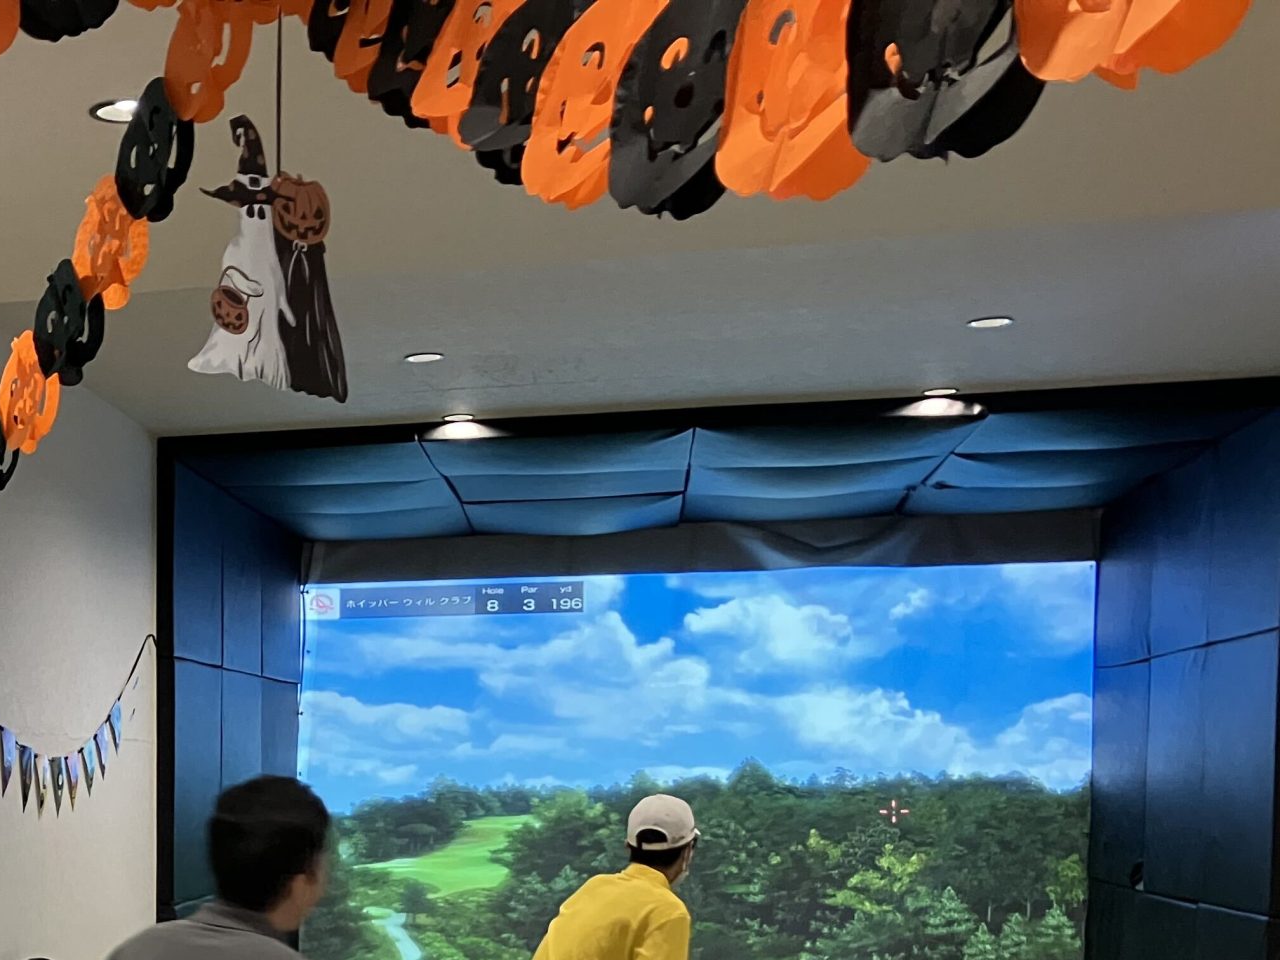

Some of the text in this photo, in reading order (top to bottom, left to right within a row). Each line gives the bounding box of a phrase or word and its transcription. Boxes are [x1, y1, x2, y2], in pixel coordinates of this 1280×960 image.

[482, 587, 504, 595] Hole
[521, 586, 538, 594] Par
[560, 585, 573, 594] yd
[486, 599, 499, 612] 8
[522, 598, 536, 611] 3
[551, 597, 583, 610] 196
